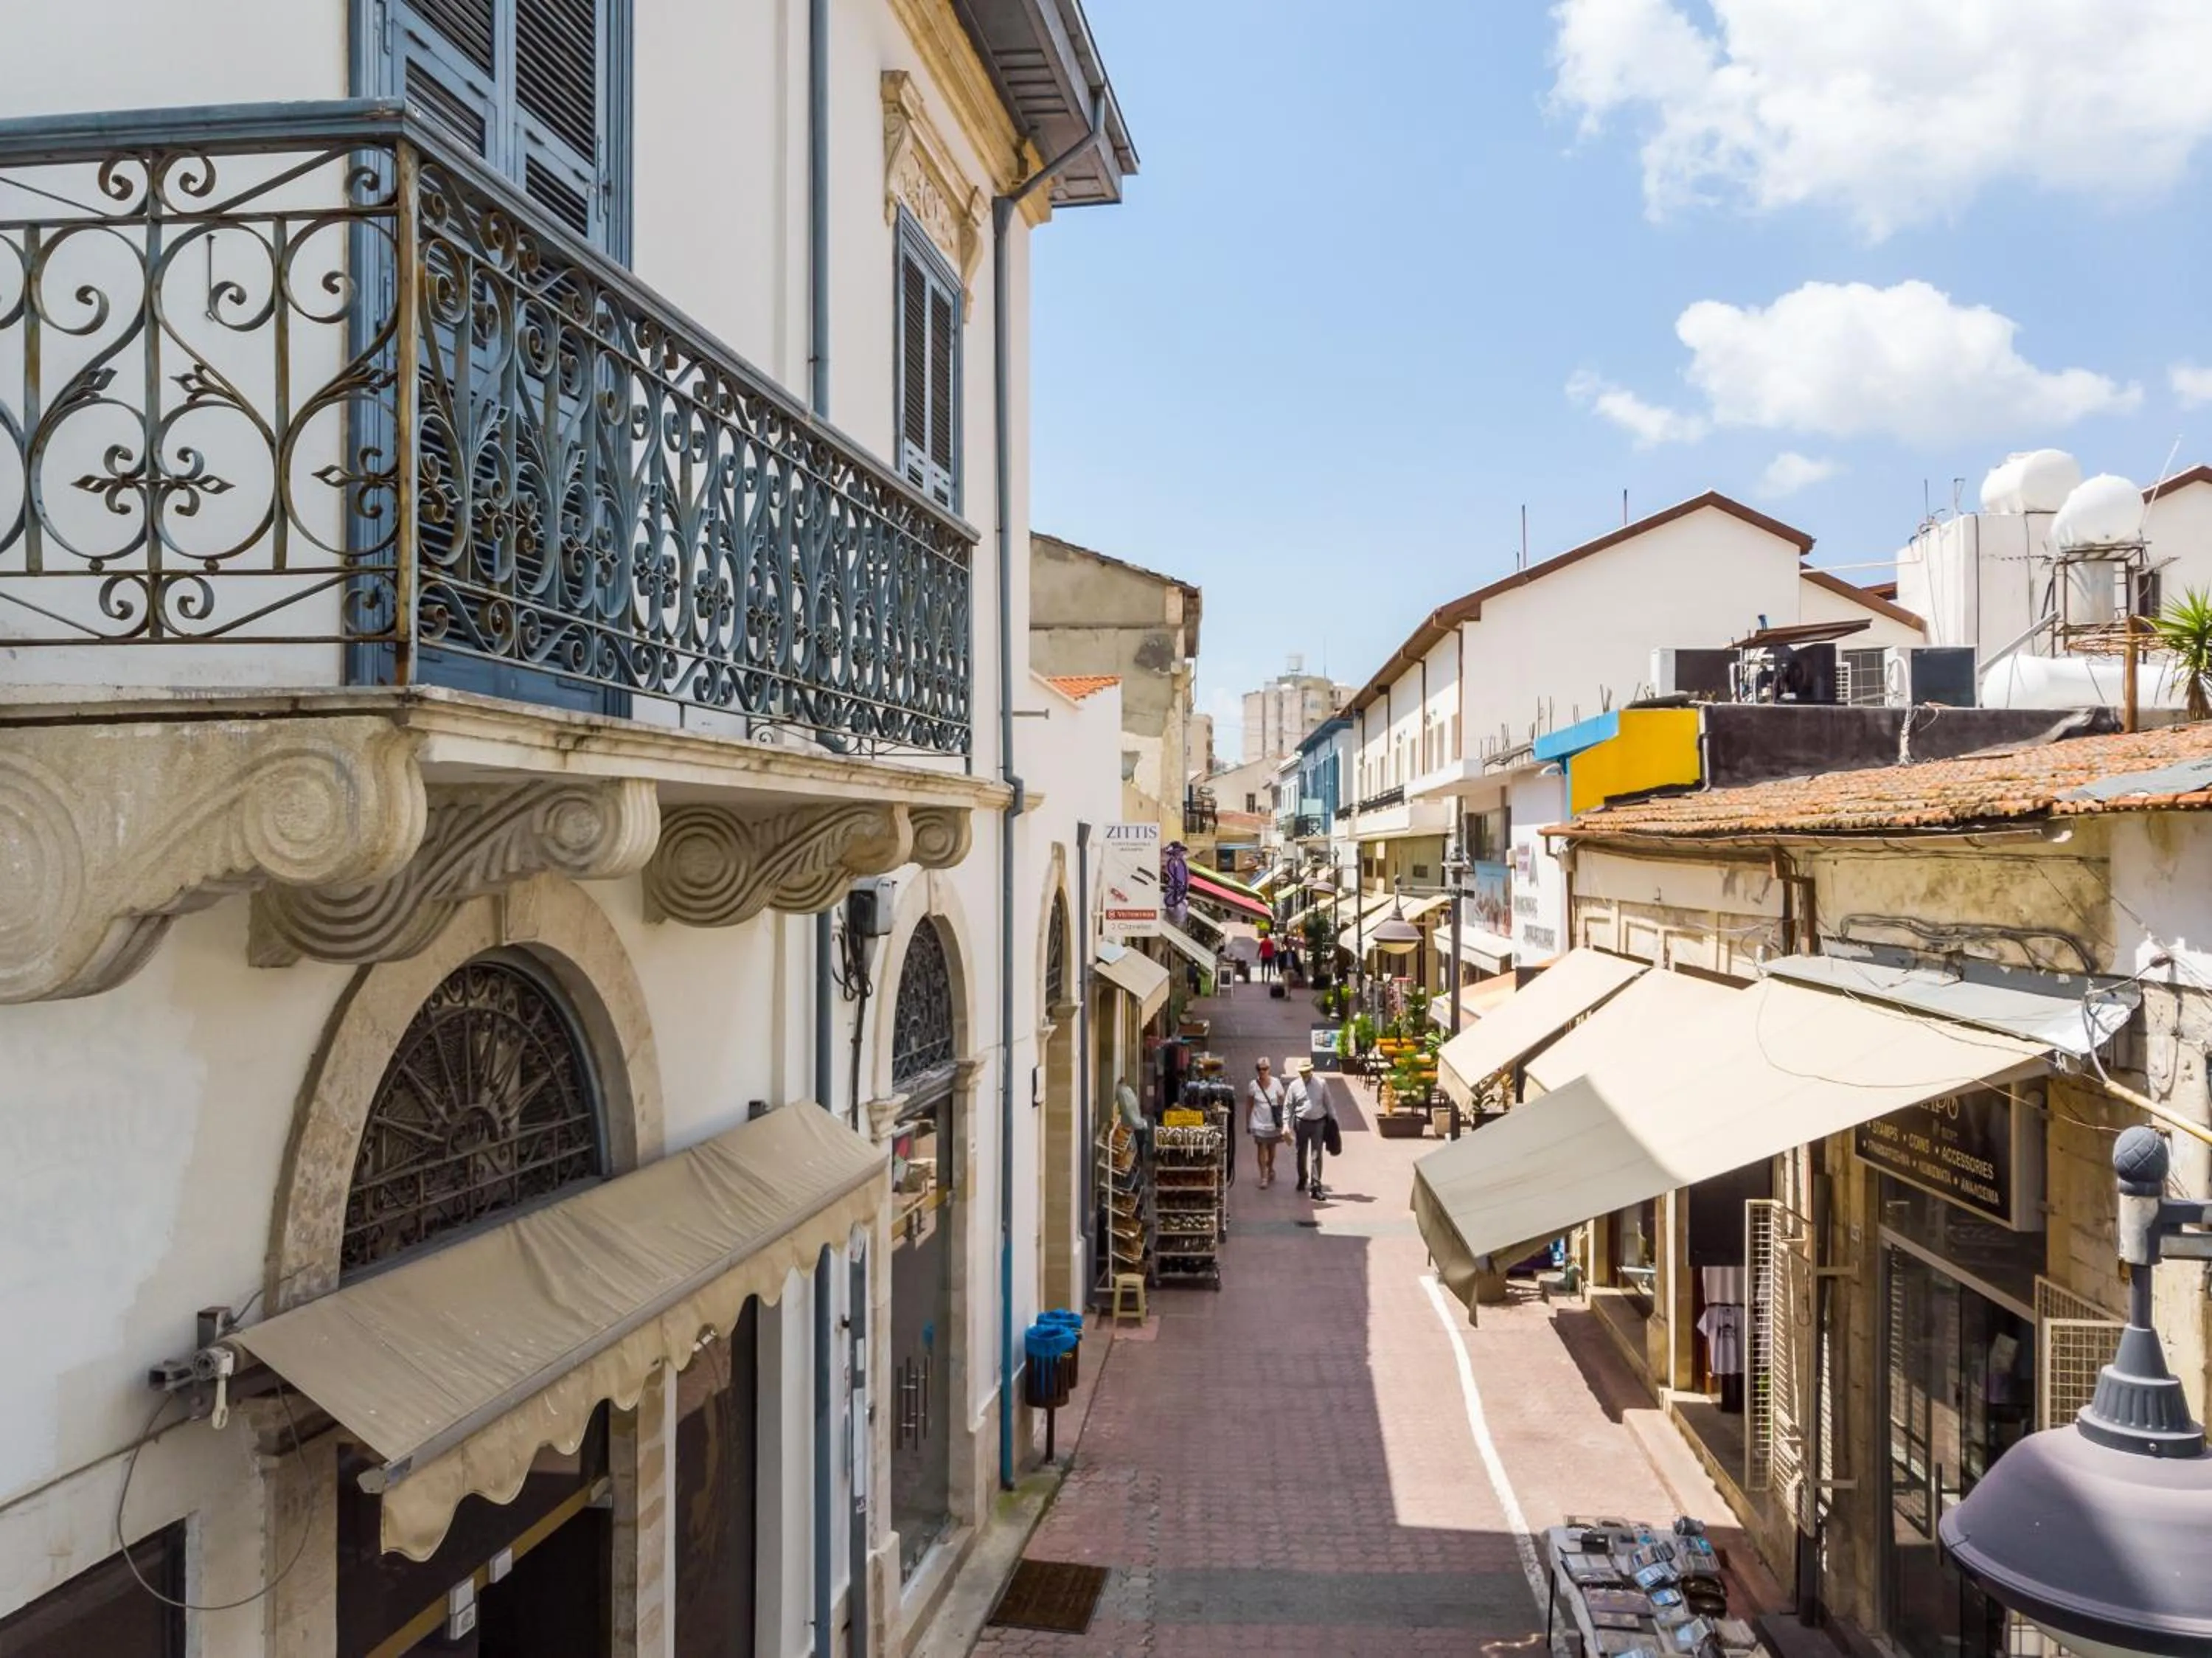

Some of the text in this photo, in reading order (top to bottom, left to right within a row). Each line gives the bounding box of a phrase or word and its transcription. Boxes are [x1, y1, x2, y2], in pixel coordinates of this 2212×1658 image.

[1106, 825, 1157, 839] ZITTIS
[1871, 1120, 1994, 1179] STAMPS COINS ACCESSORIES
